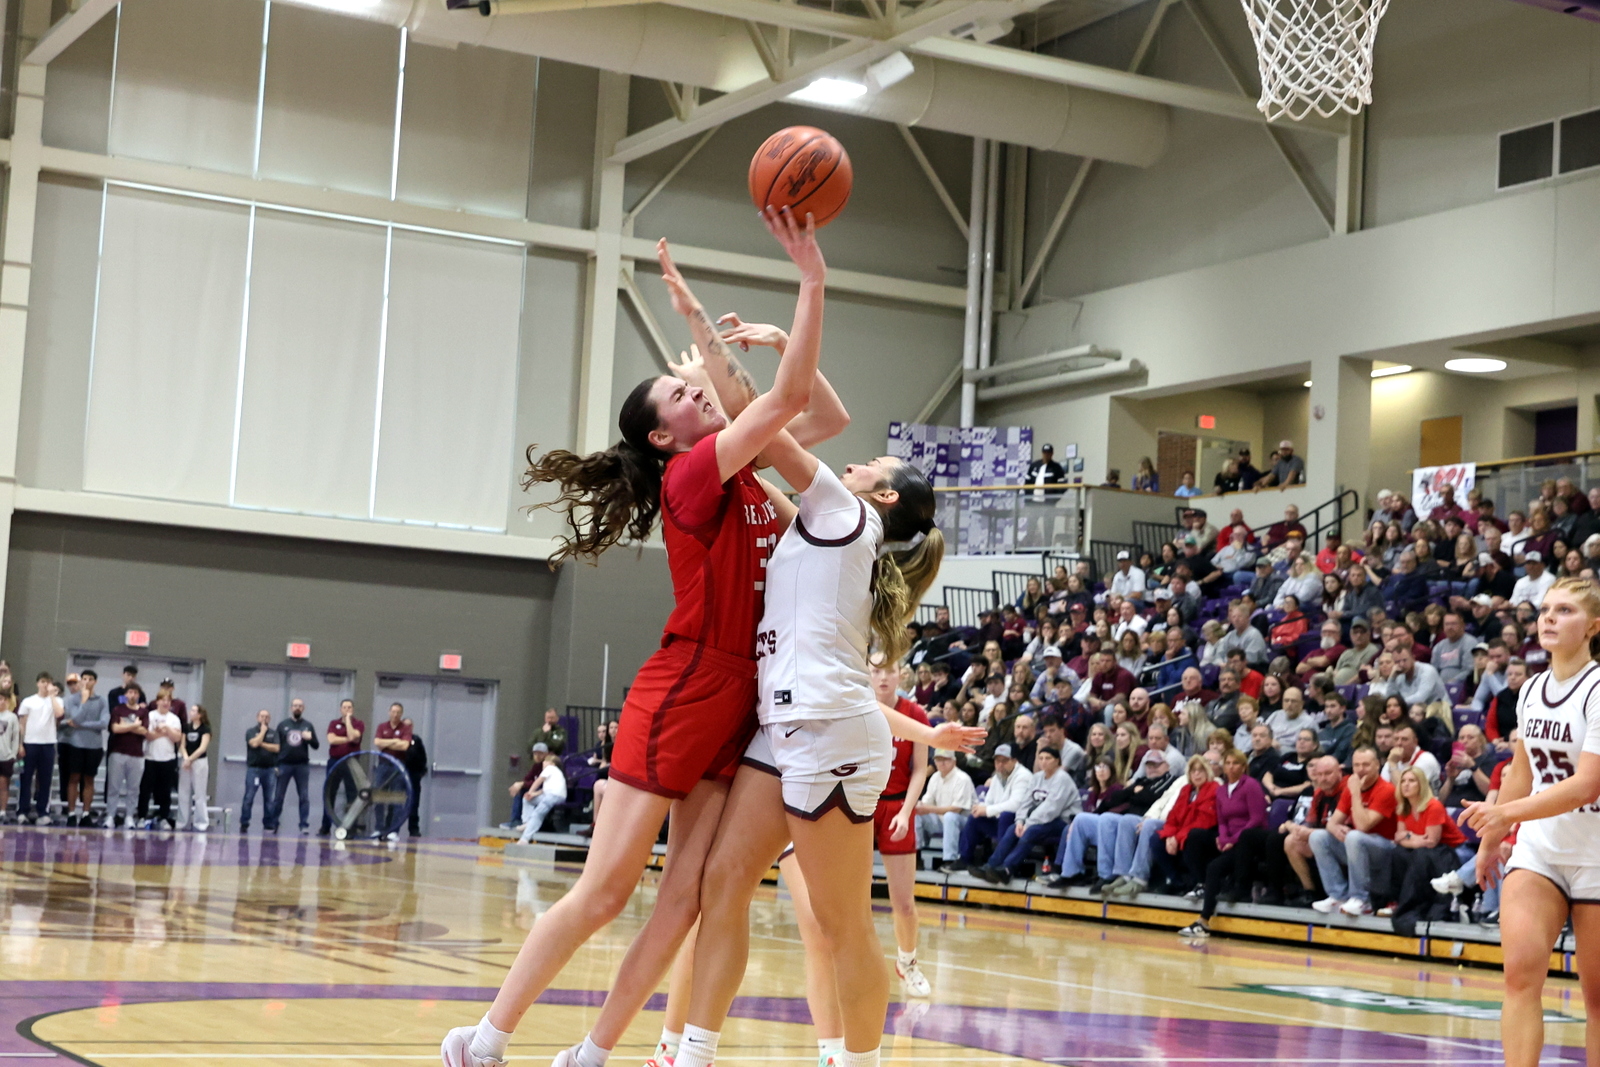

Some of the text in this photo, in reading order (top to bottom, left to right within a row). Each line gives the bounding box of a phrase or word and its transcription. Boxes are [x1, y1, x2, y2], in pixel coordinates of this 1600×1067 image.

[1525, 718, 1574, 743] GENOA
[829, 762, 860, 778] G
[1530, 747, 1575, 784] 25
